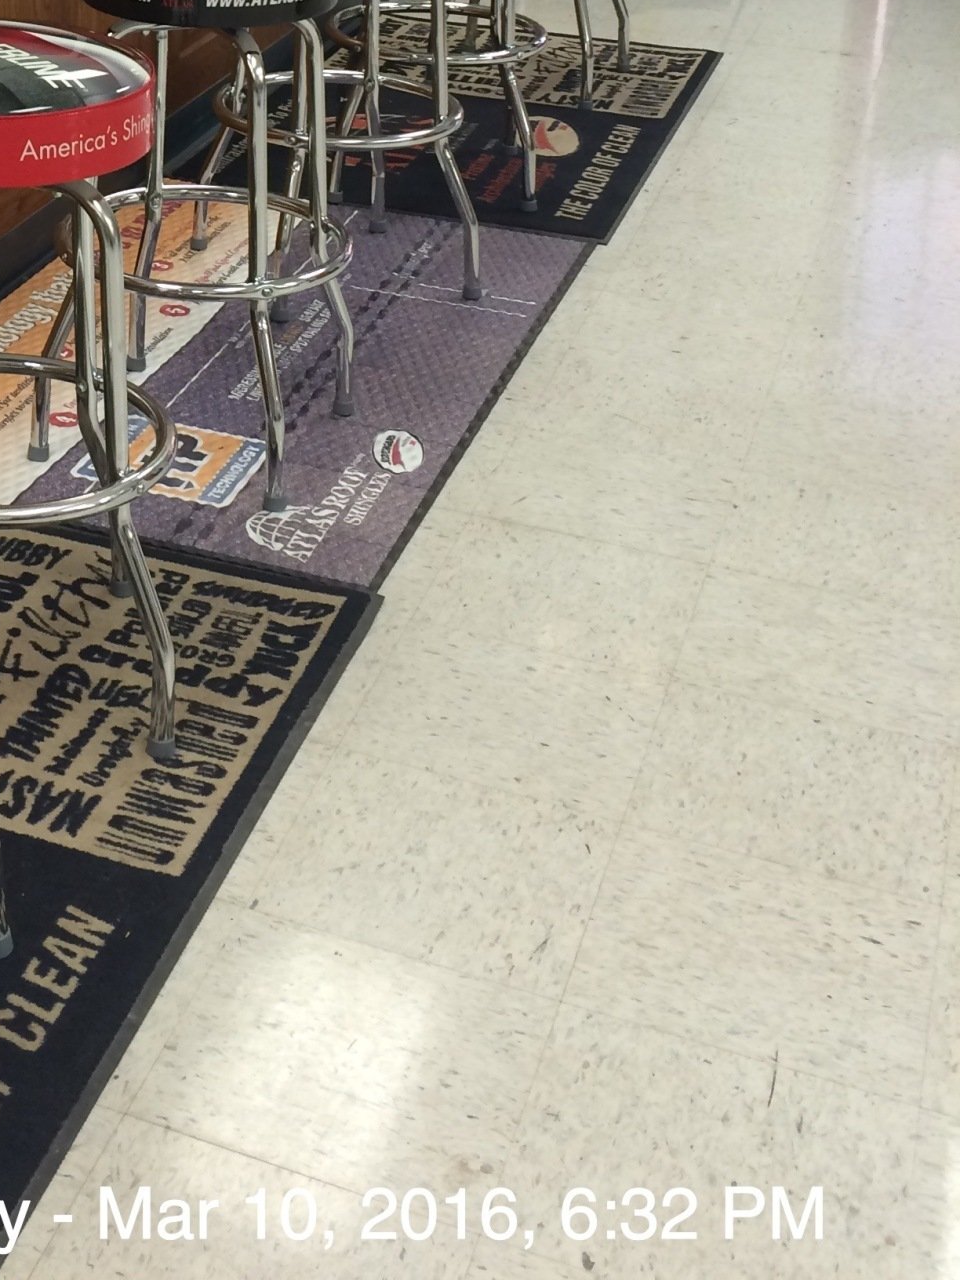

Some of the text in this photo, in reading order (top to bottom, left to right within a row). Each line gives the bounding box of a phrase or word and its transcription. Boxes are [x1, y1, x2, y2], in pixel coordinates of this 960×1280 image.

[19, 125, 118, 162] America's
[554, 124, 641, 220] THE COLOR OF CLEAN
[206, 442, 261, 501] TECHNOLOGY
[344, 470, 392, 527] SHINGLES
[282, 462, 370, 563] ATLAS ROOF
